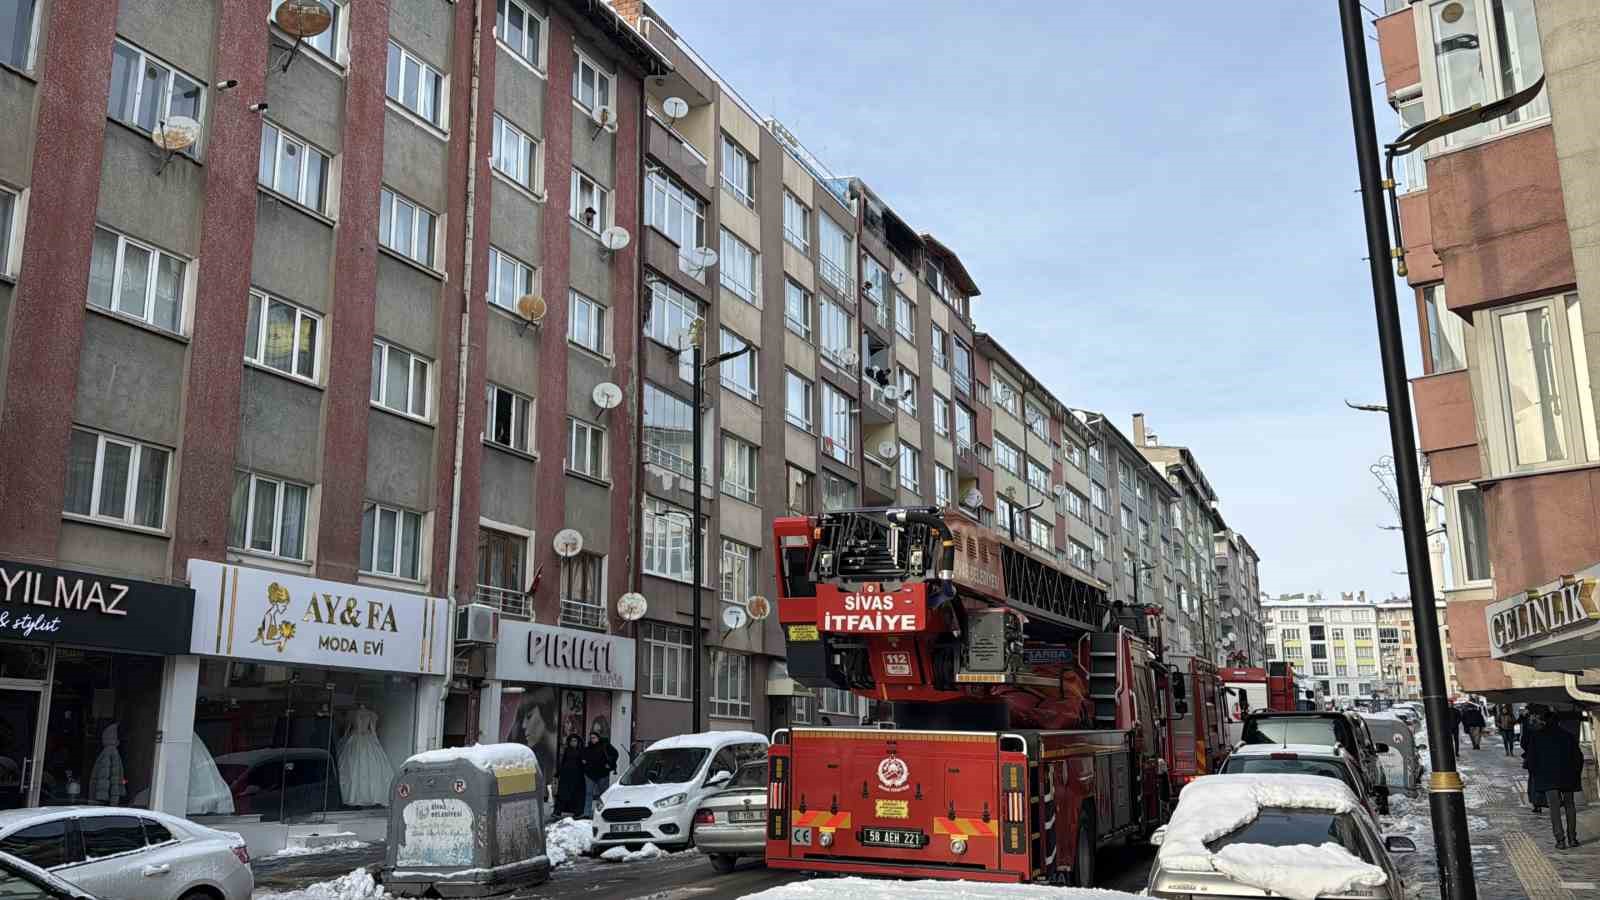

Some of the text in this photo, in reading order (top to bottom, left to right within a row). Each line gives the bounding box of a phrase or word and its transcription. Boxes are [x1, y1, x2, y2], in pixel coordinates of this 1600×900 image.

[0, 567, 129, 616] YILMAZ
[845, 592, 894, 610] SİVAS
[13, 613, 62, 638] stylist
[824, 611, 916, 631] İTFAİYE
[318, 635, 385, 657] MODA EVİ
[887, 654, 907, 664] 112
[869, 831, 920, 845] 58 AEH 221
